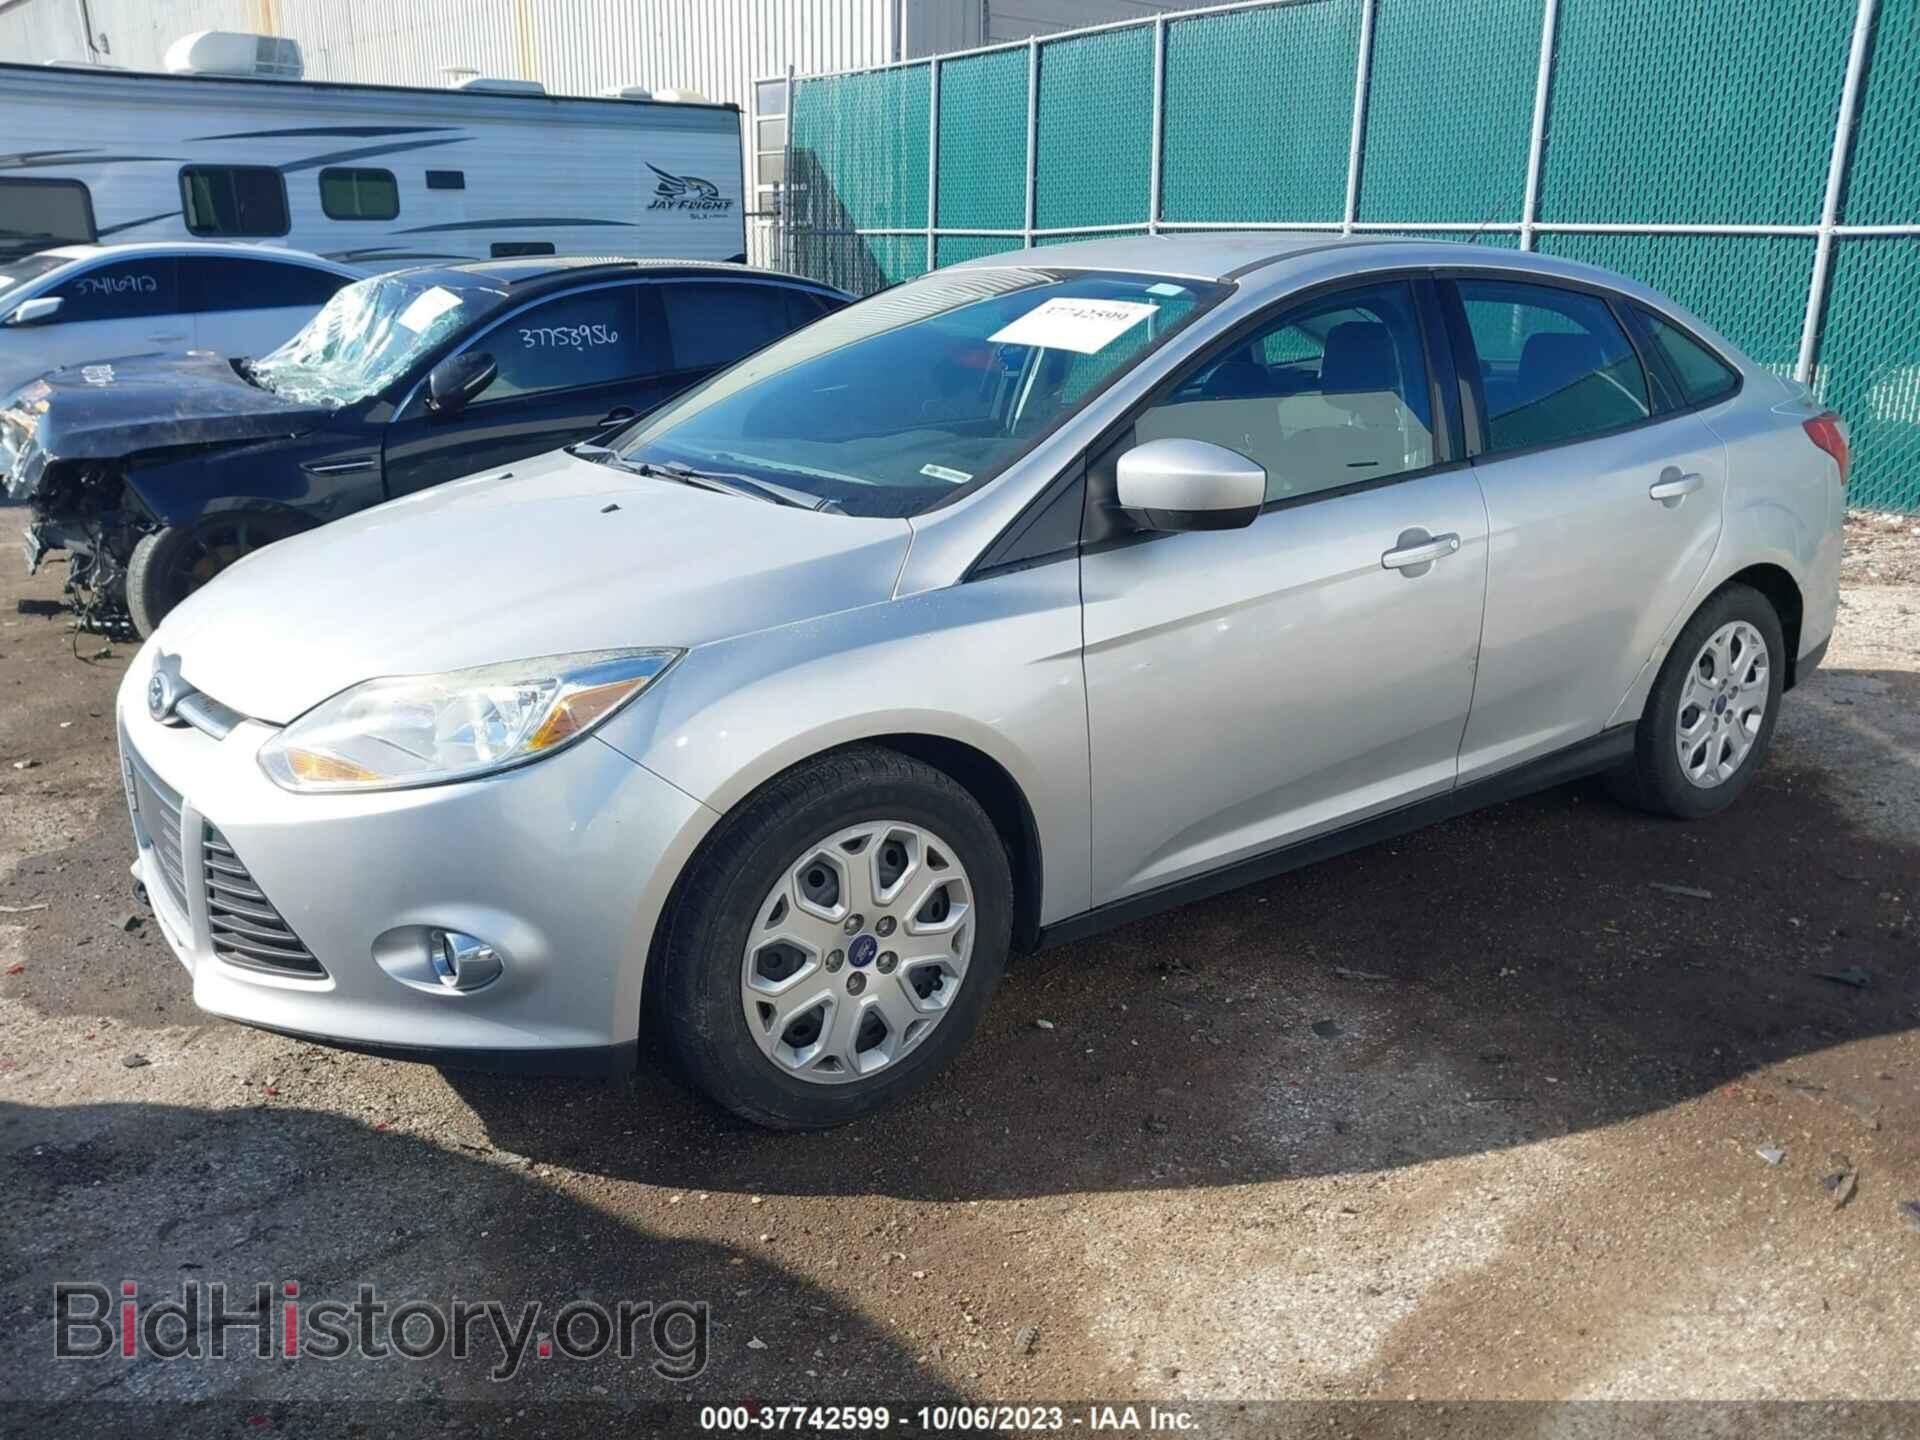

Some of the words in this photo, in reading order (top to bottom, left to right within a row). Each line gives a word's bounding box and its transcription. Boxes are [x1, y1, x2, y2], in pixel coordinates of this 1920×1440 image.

[647, 200, 676, 209] JAY
[678, 200, 734, 210] FLIGHT
[519, 324, 618, 348] 37753956
